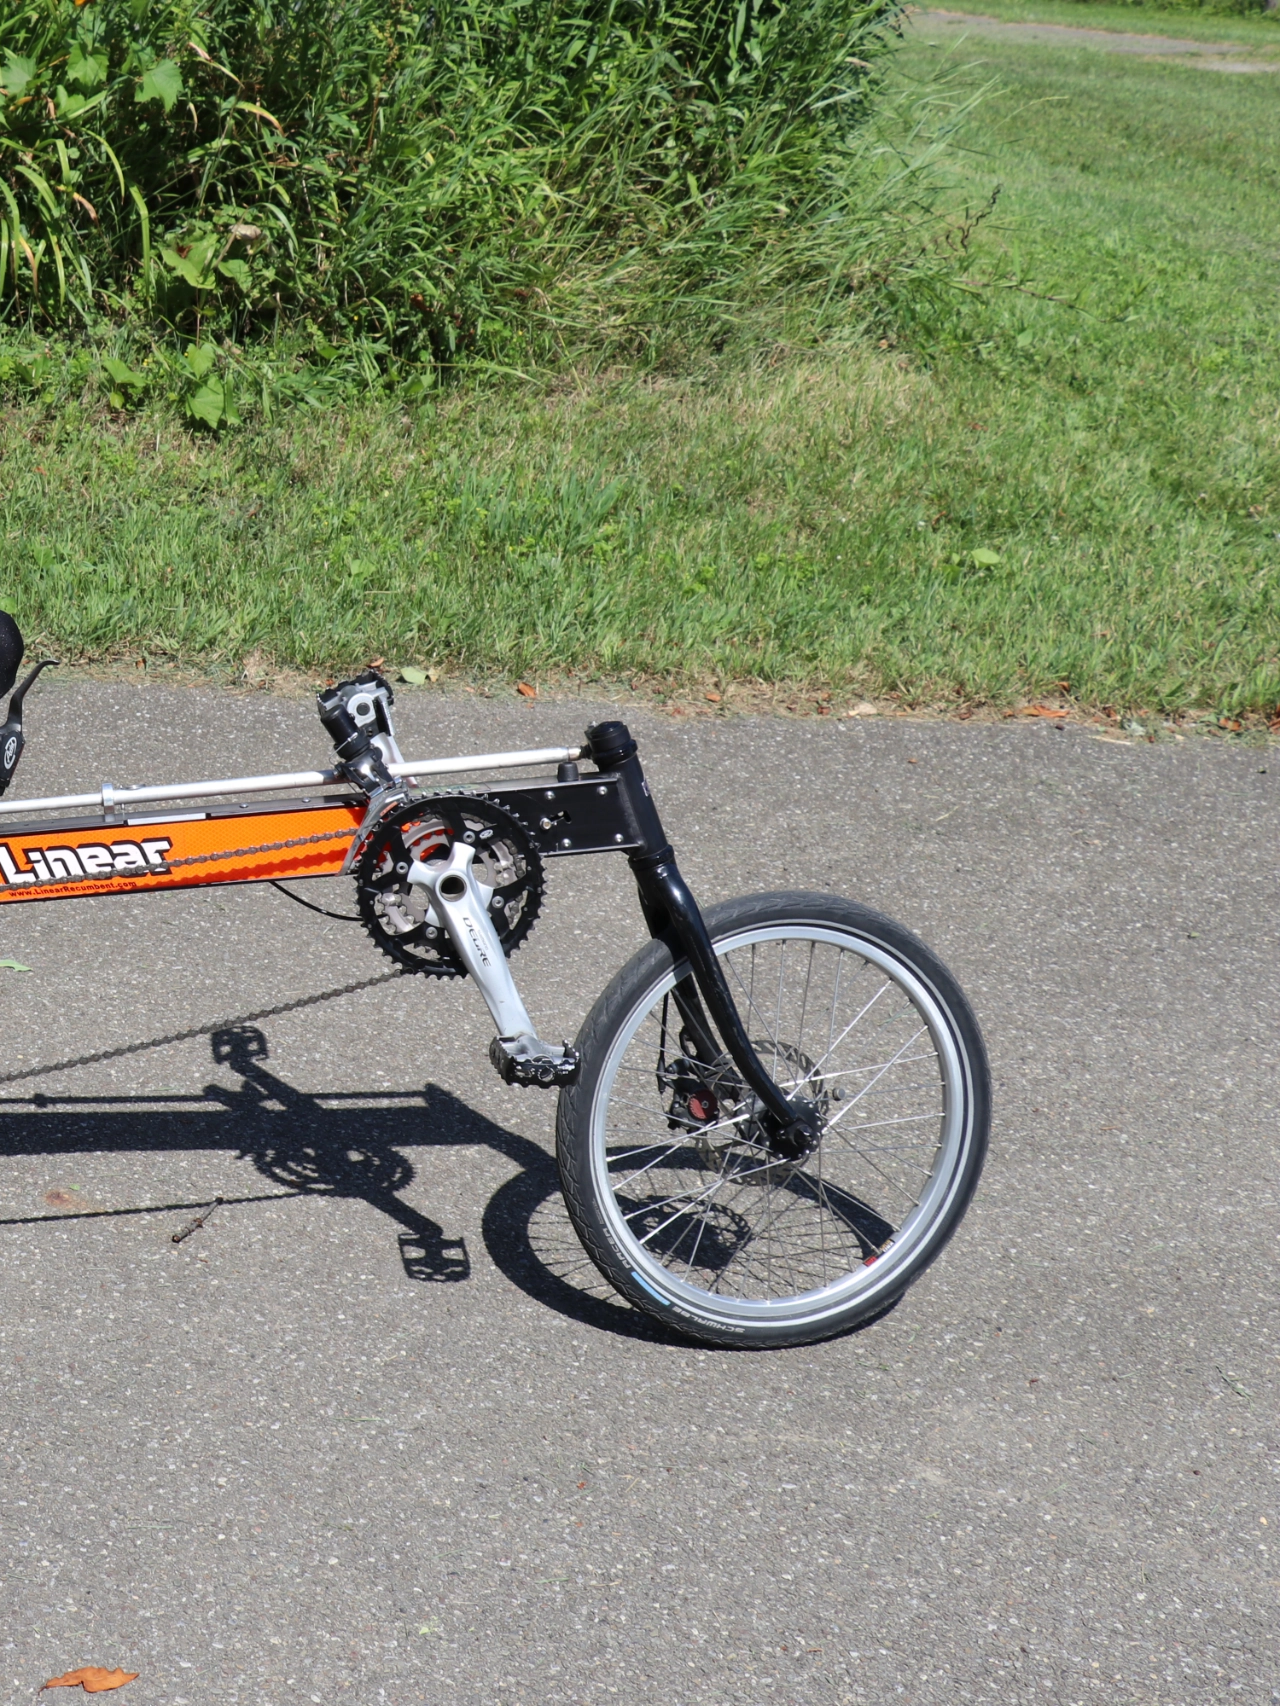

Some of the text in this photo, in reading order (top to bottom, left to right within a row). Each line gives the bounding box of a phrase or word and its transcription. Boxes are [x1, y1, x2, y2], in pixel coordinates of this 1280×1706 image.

[8, 881, 137, 897] www.LinearRecumbent.com
[602, 1227, 631, 1269] RACER
[673, 1306, 745, 1333] SCHWALBE
